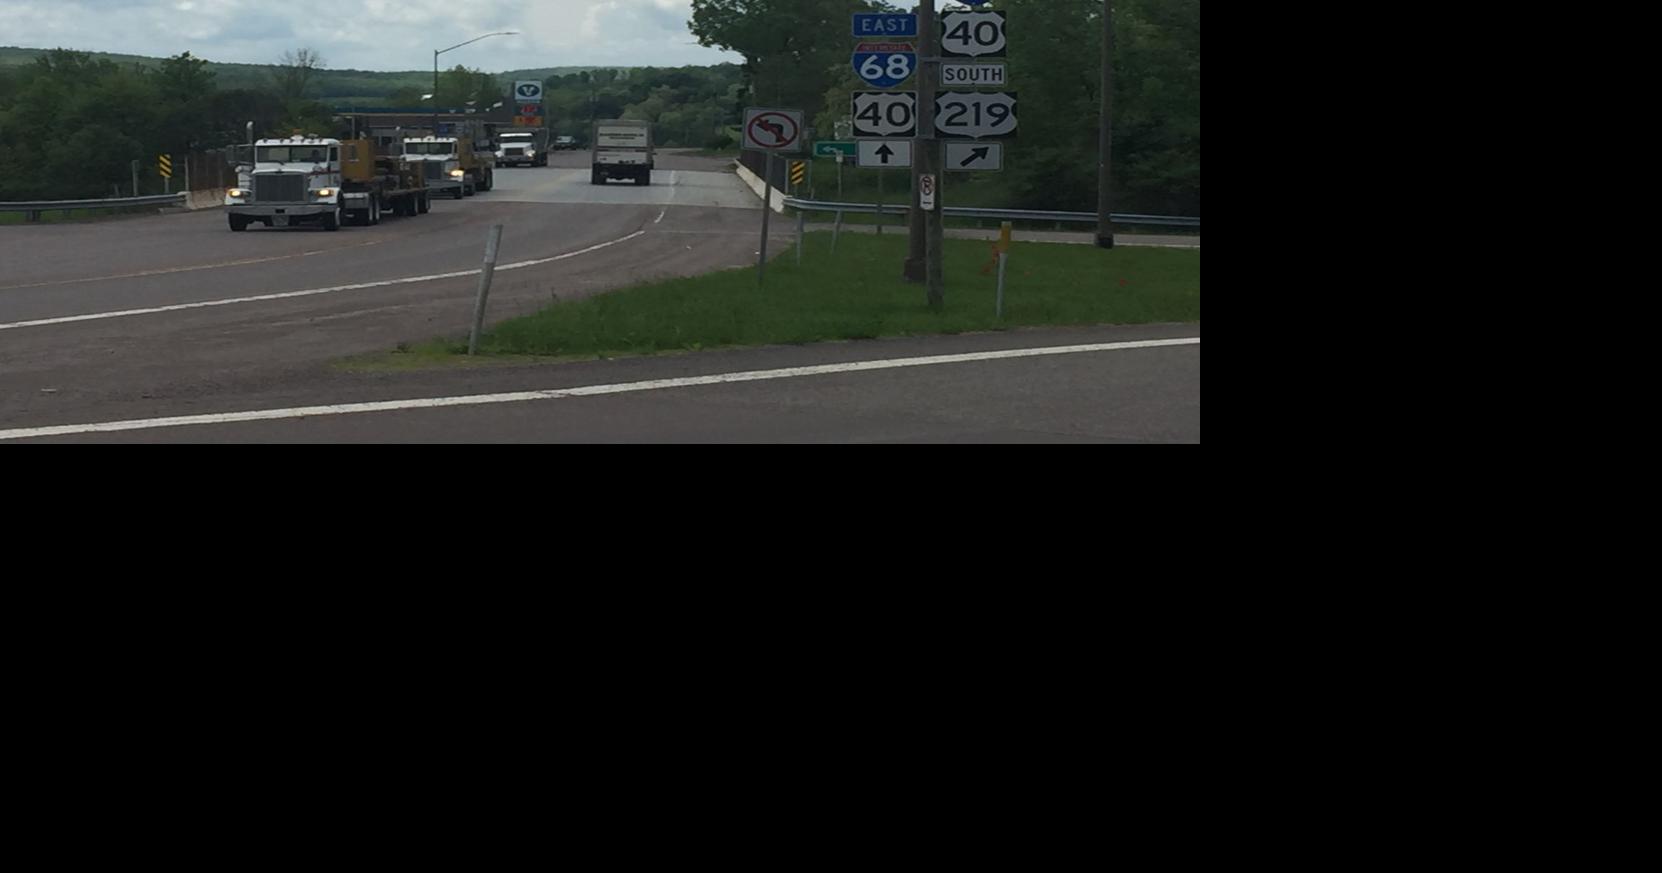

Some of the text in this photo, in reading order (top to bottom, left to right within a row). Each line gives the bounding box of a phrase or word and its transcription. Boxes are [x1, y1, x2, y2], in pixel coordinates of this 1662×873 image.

[862, 18, 908, 31] EAST
[946, 20, 999, 46] 40
[860, 54, 910, 79] 68
[945, 67, 1002, 81] SOUTH
[856, 102, 911, 127] 40
[944, 102, 1009, 127] 219
